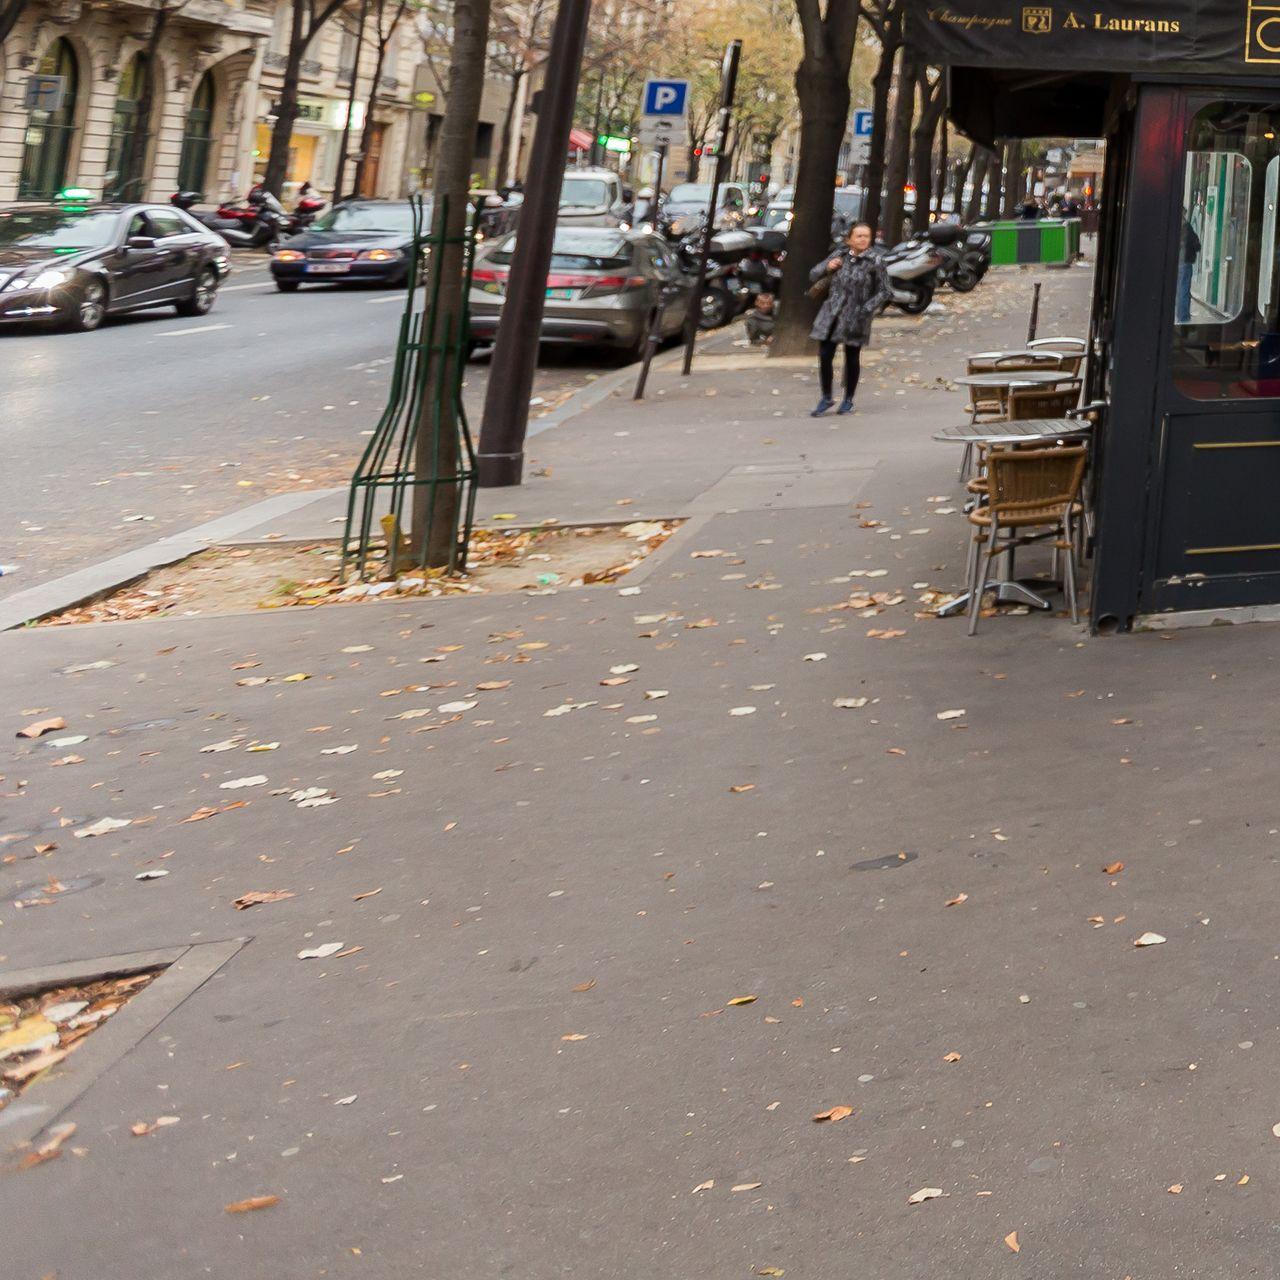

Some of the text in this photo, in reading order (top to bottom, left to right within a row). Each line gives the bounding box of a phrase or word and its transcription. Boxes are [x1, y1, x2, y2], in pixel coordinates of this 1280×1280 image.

[926, 7, 1181, 33] Champagne A. Laurans
[654, 86, 678, 110] P
